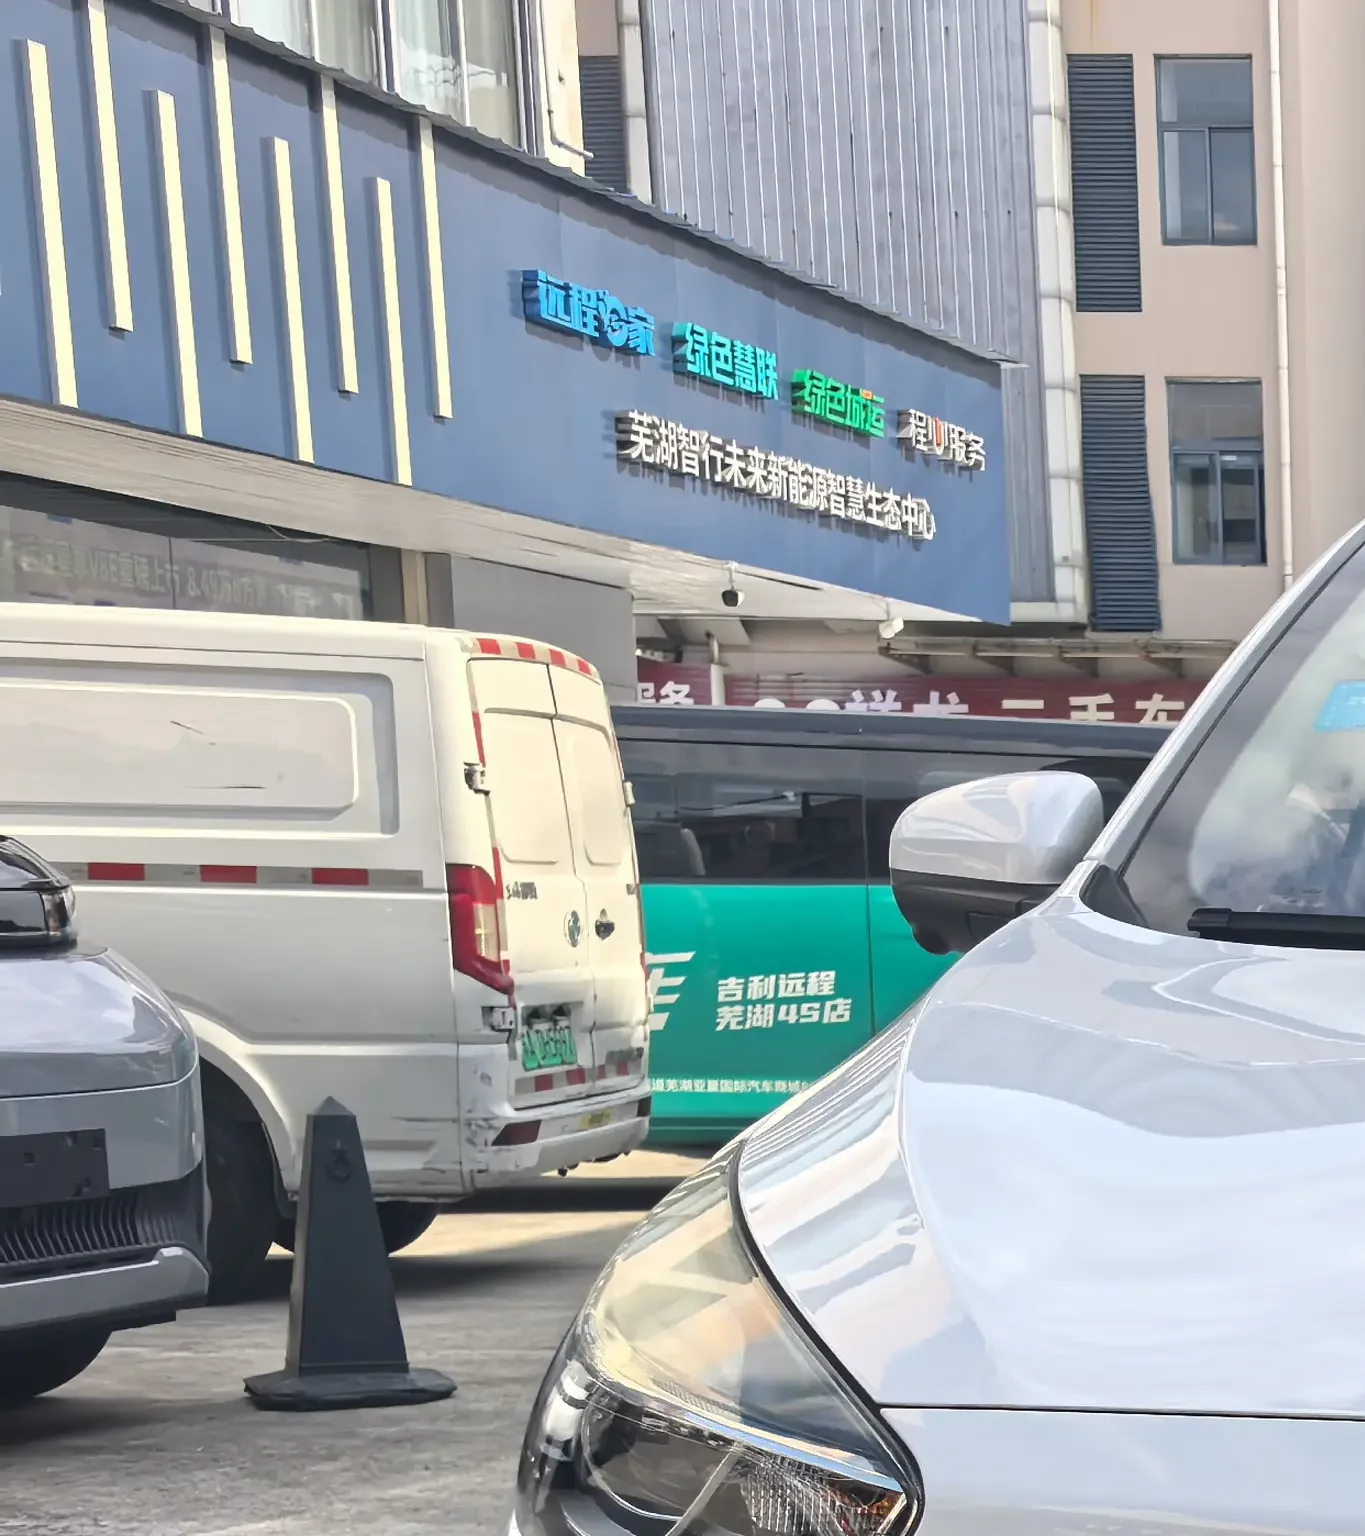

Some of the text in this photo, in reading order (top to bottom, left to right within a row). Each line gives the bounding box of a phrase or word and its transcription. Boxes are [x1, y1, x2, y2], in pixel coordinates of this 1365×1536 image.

[680, 322, 780, 401] 绿色慧联
[625, 408, 937, 541] 芜湖智行未来新能源智慧生态中心
[715, 997, 853, 1032] 芜湖4S店
[717, 970, 836, 1003] 吉利远程
